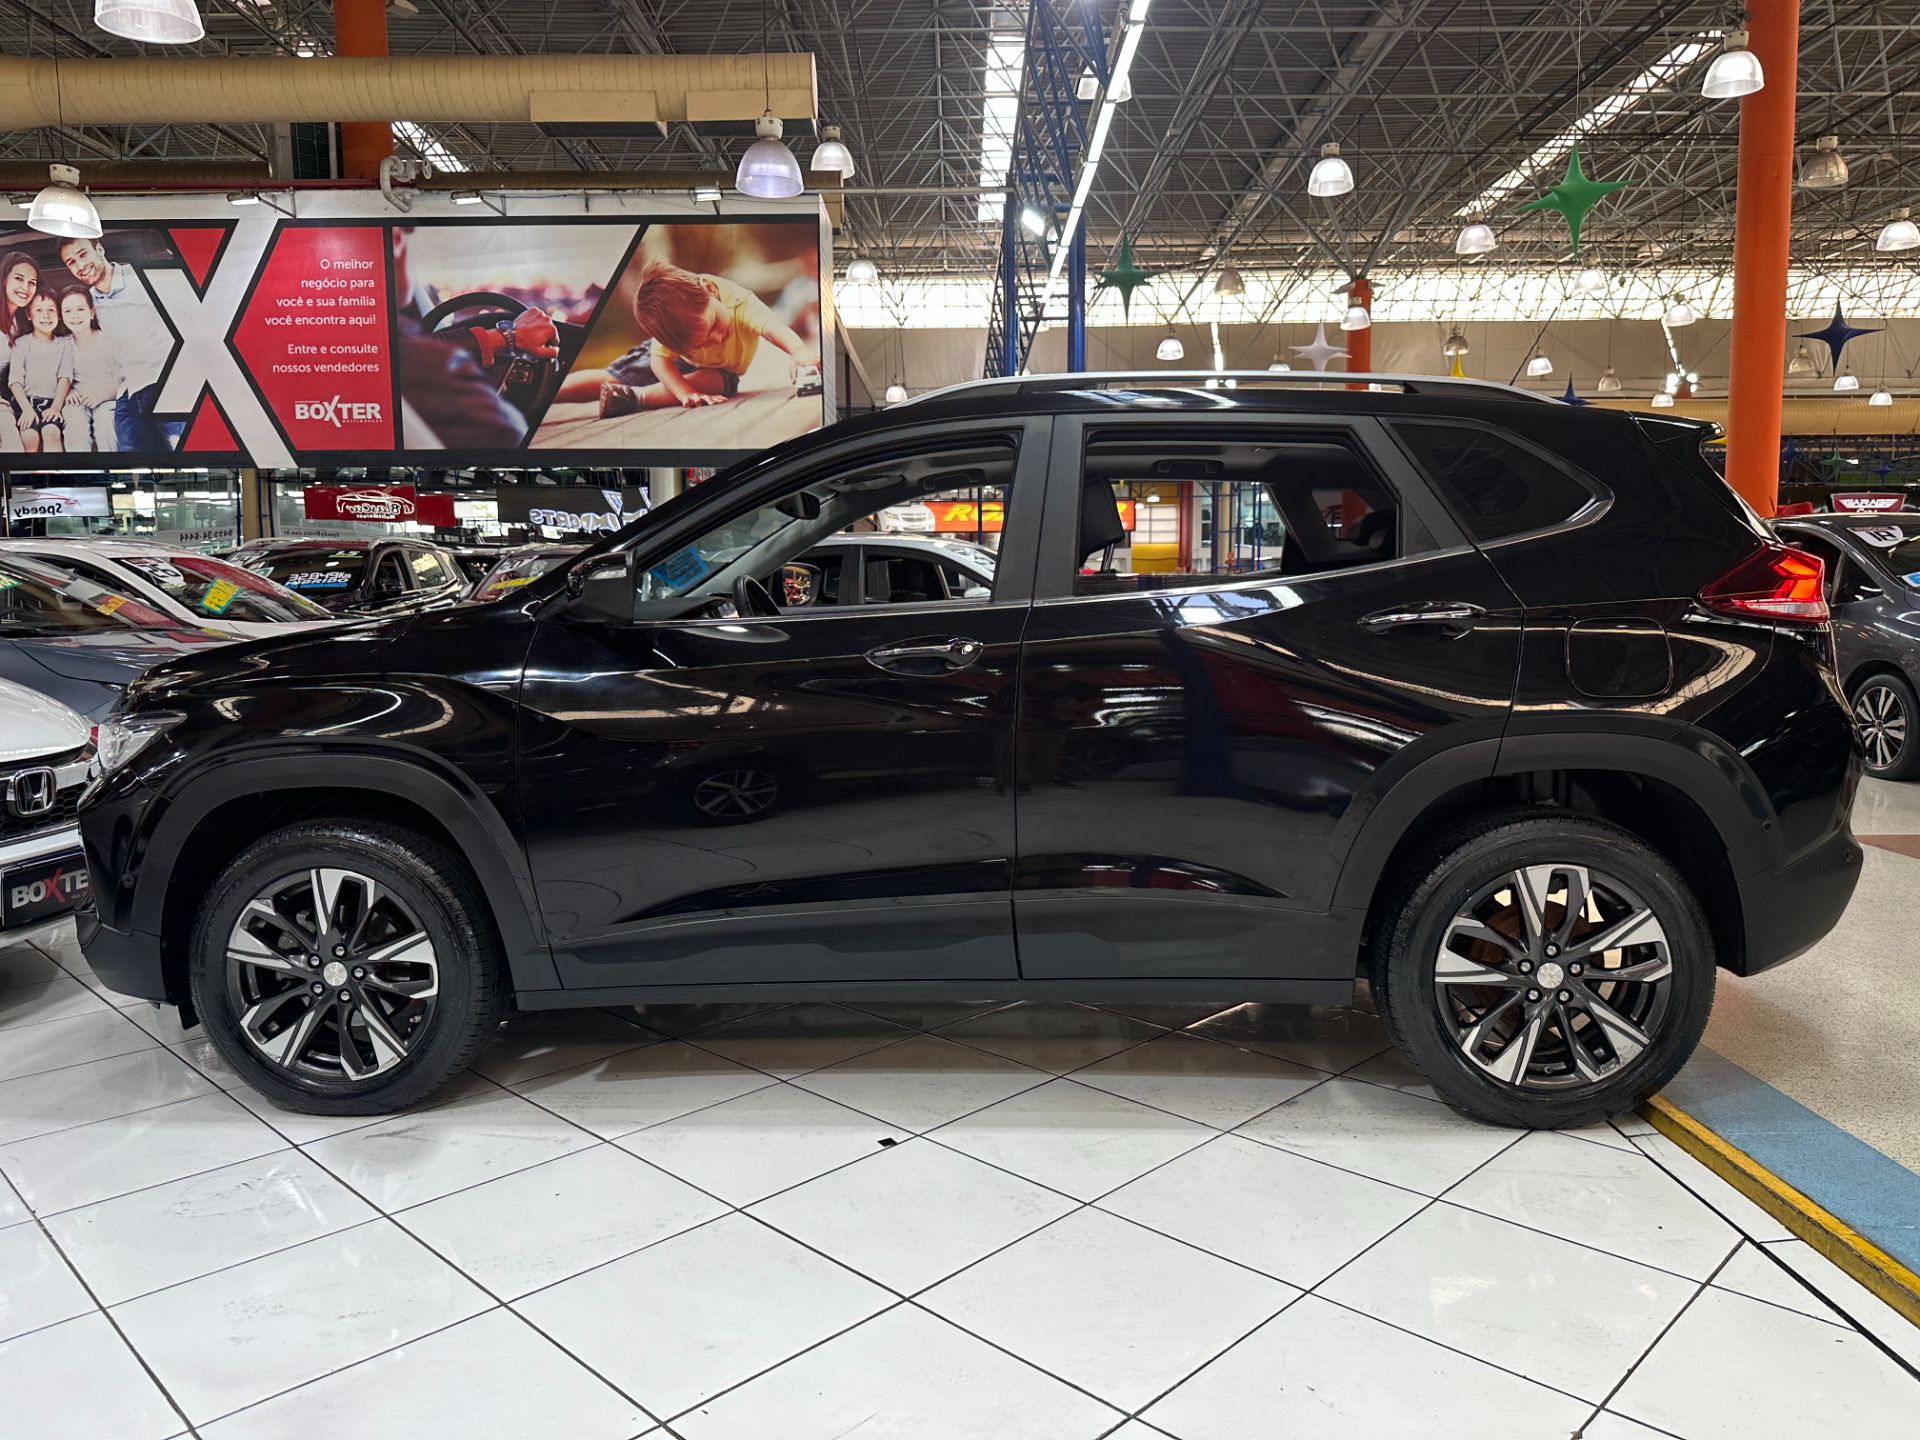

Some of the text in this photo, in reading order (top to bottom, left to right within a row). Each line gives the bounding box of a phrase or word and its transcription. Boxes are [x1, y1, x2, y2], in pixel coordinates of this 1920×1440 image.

[320, 259, 374, 270] O melhor
[301, 278, 375, 290] negócio para
[276, 296, 376, 307] você e sua família
[265, 315, 376, 327] você encontra aqui!
[287, 343, 379, 354] Entre e consulte
[272, 362, 380, 373] nossos vendedores
[294, 395, 382, 428] BOXTER
[11, 868, 90, 909] BOXTE
